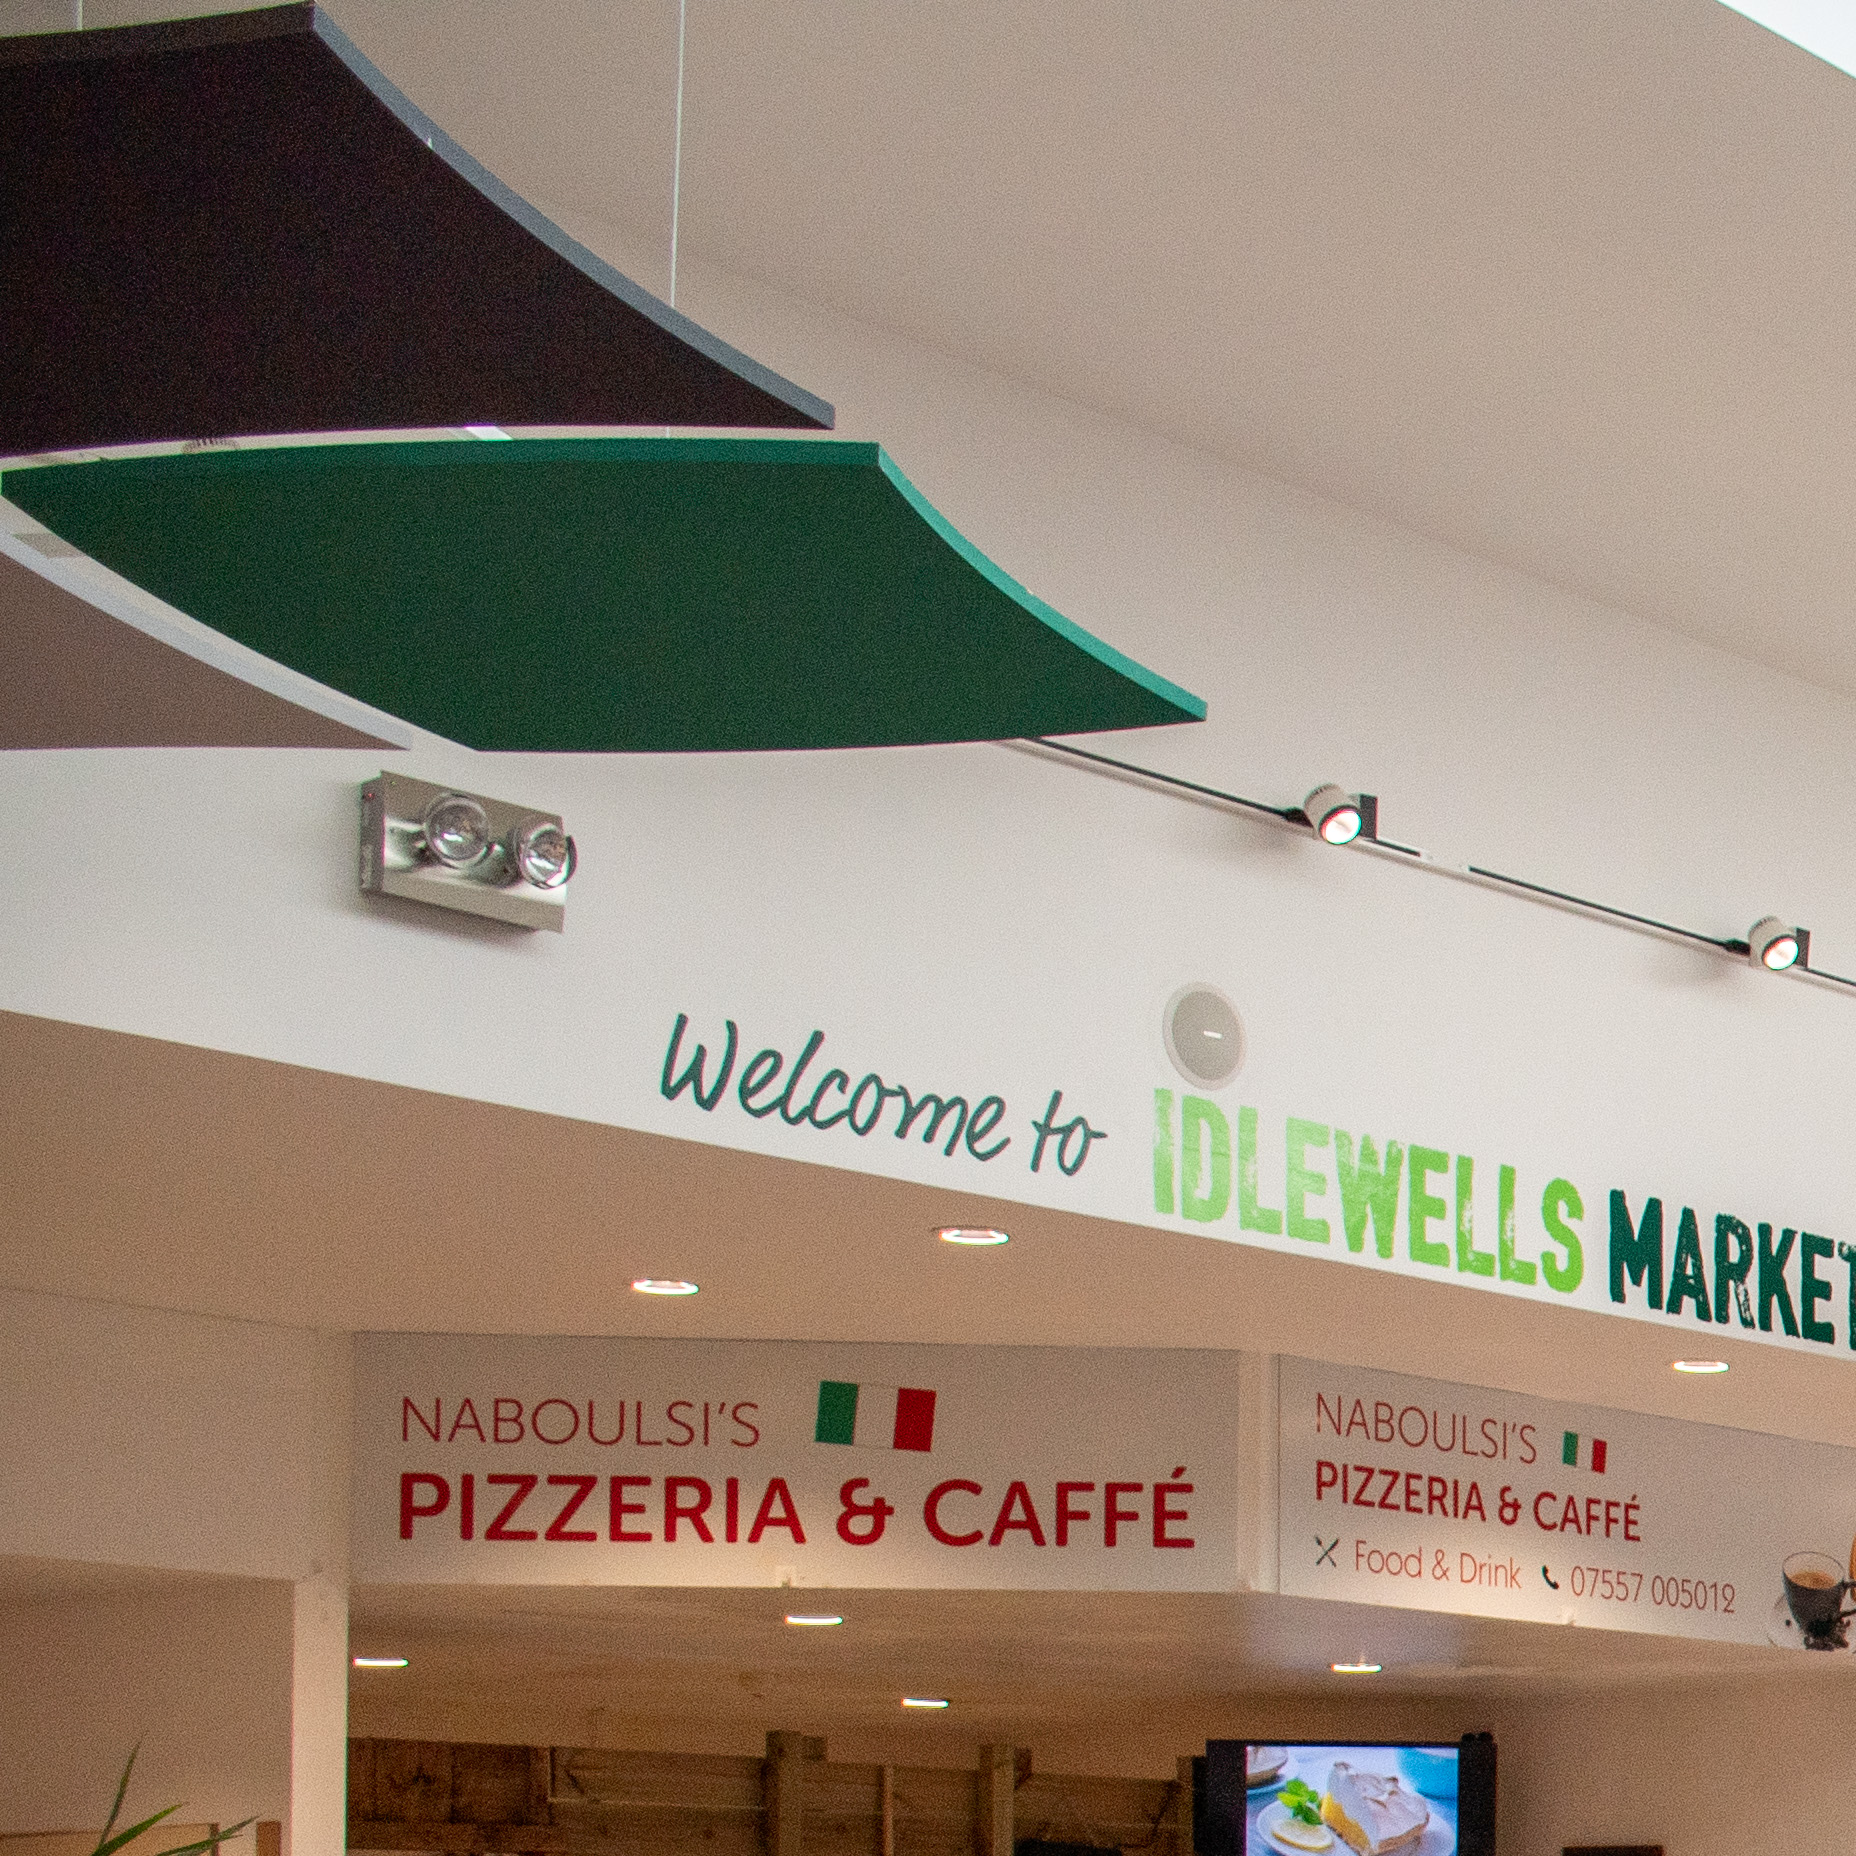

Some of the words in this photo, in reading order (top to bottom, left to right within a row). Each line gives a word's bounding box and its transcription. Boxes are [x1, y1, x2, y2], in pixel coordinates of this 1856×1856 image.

[661, 1013, 1011, 1161] Welcome
[1031, 1090, 1108, 1176] to
[1153, 1086, 1586, 1294] IDLEWELLS
[401, 1396, 760, 1449] NABOULSI'S
[1316, 1393, 1537, 1464] NABOULSI'S
[400, 1473, 807, 1546] PIZZERIA
[835, 1477, 894, 1546] &
[923, 1466, 1196, 1549] CAFFÉ
[1316, 1460, 1487, 1522] PIZZERIA
[1499, 1486, 1522, 1525] &
[1533, 1495, 1641, 1542] CAFFÉ
[1355, 1539, 1423, 1578] Food
[1432, 1550, 1451, 1580] &
[1460, 1552, 1523, 1590] Drink
[1571, 1566, 1644, 1601] 07557
[1651, 1575, 1737, 1614] 005012
